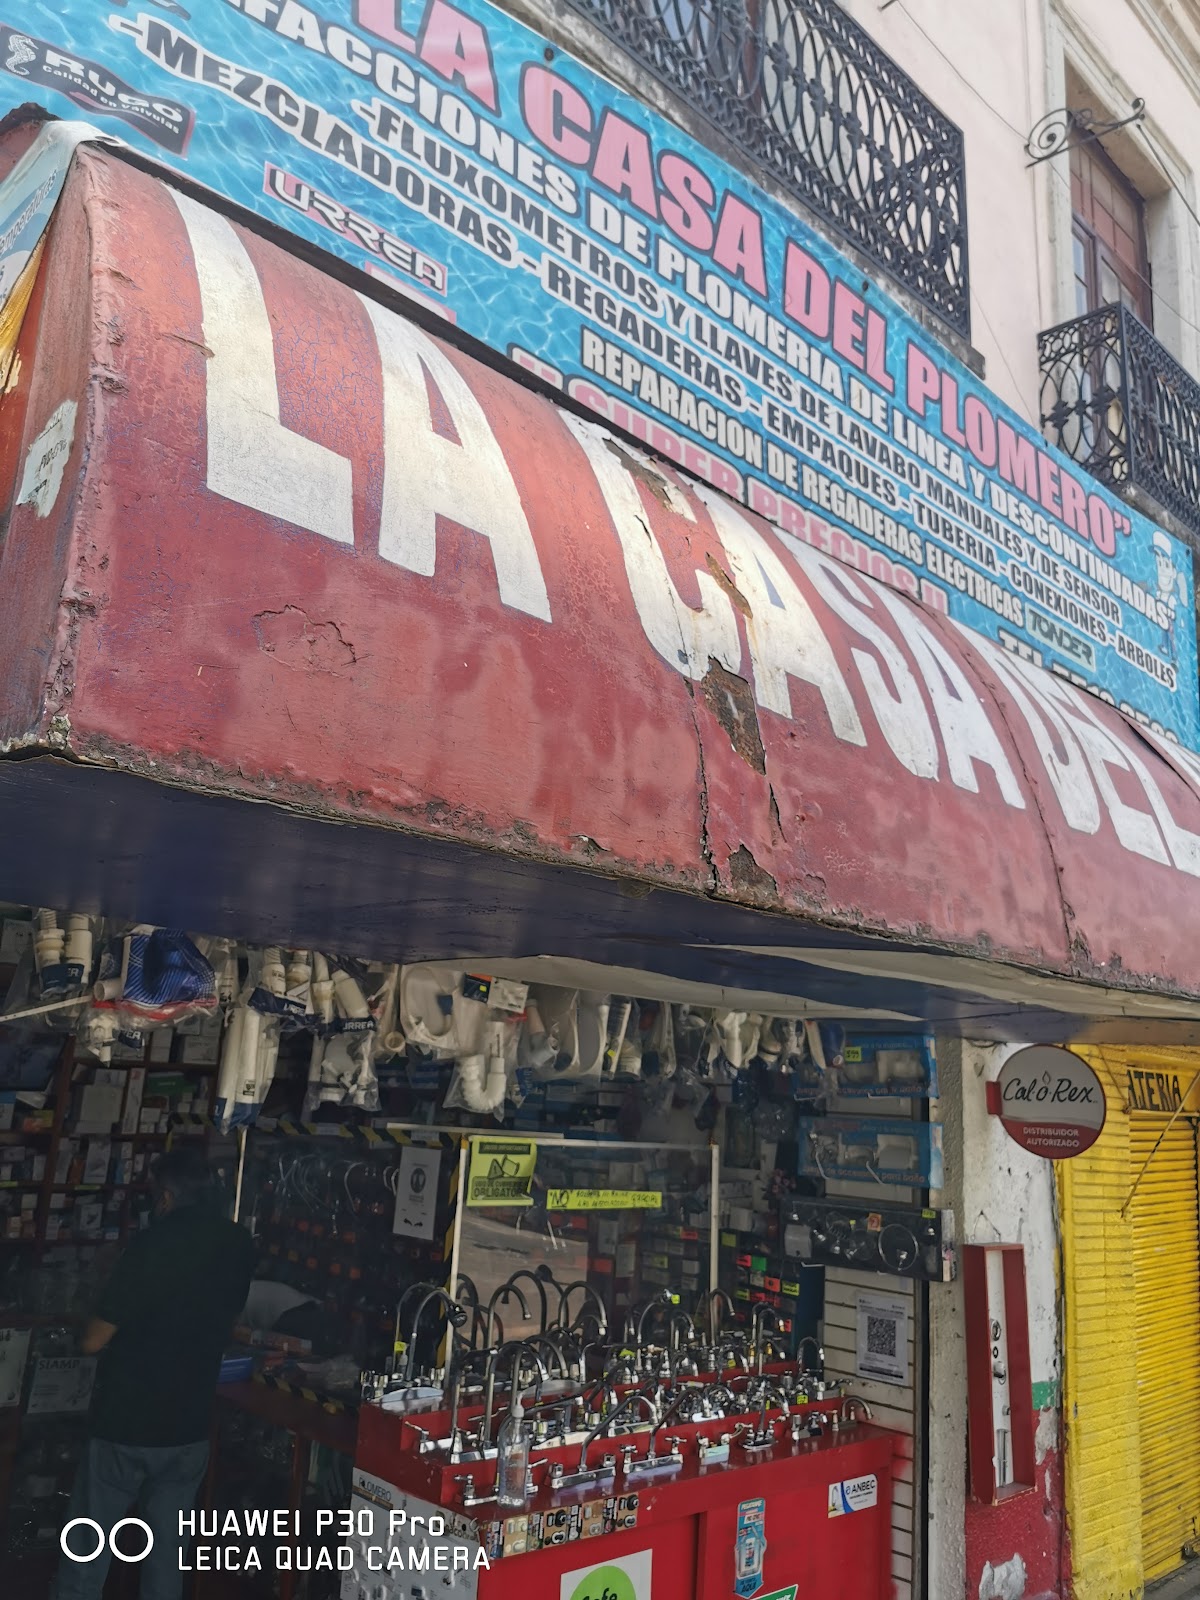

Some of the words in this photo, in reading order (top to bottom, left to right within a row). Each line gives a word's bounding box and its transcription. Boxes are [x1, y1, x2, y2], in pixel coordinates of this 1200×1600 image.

[42, 65, 97, 96] Calidad
[100, 96, 117, 108] en
[271, 168, 444, 291] URREA
[355, 0, 498, 113] LA
[521, 62, 768, 298] CASA
[784, 240, 894, 393] DEL
[226, 0, 578, 216] FACCIONES
[589, 189, 648, 263] DE
[658, 238, 845, 401] PLOMERIA
[851, 375, 888, 432] DE
[894, 410, 967, 490] LINEA
[969, 467, 987, 500] Y
[171, 186, 552, 623] LA
[558, 408, 1026, 810] CASA
[549, 264, 743, 408] REGADERAS
[767, 401, 895, 507] EMPAQUES
[913, 499, 997, 571] TUBERIA
[1010, 565, 1107, 642] CONEXIONES
[1117, 636, 1175, 688] ARBOLES
[583, 329, 761, 470] REPARACION
[768, 440, 798, 490] DE
[803, 464, 923, 564] REGADERAS
[926, 543, 1024, 628] ELECTRICAS
[667, 300, 685, 328] Y
[694, 312, 793, 402] LLAVES
[801, 389, 830, 424] DE
[837, 411, 920, 489] LAVABO
[926, 473, 1022, 555] MANUALES
[1022, 543, 1036, 566] Y
[1040, 551, 1060, 585] DE
[1063, 570, 1121, 624] SENSOR
[1029, 609, 1094, 667] TONDER
[1023, 1126, 1079, 1138] DISTRIBUIDOR
[1026, 1137, 1080, 1148] AUTORIZADO
